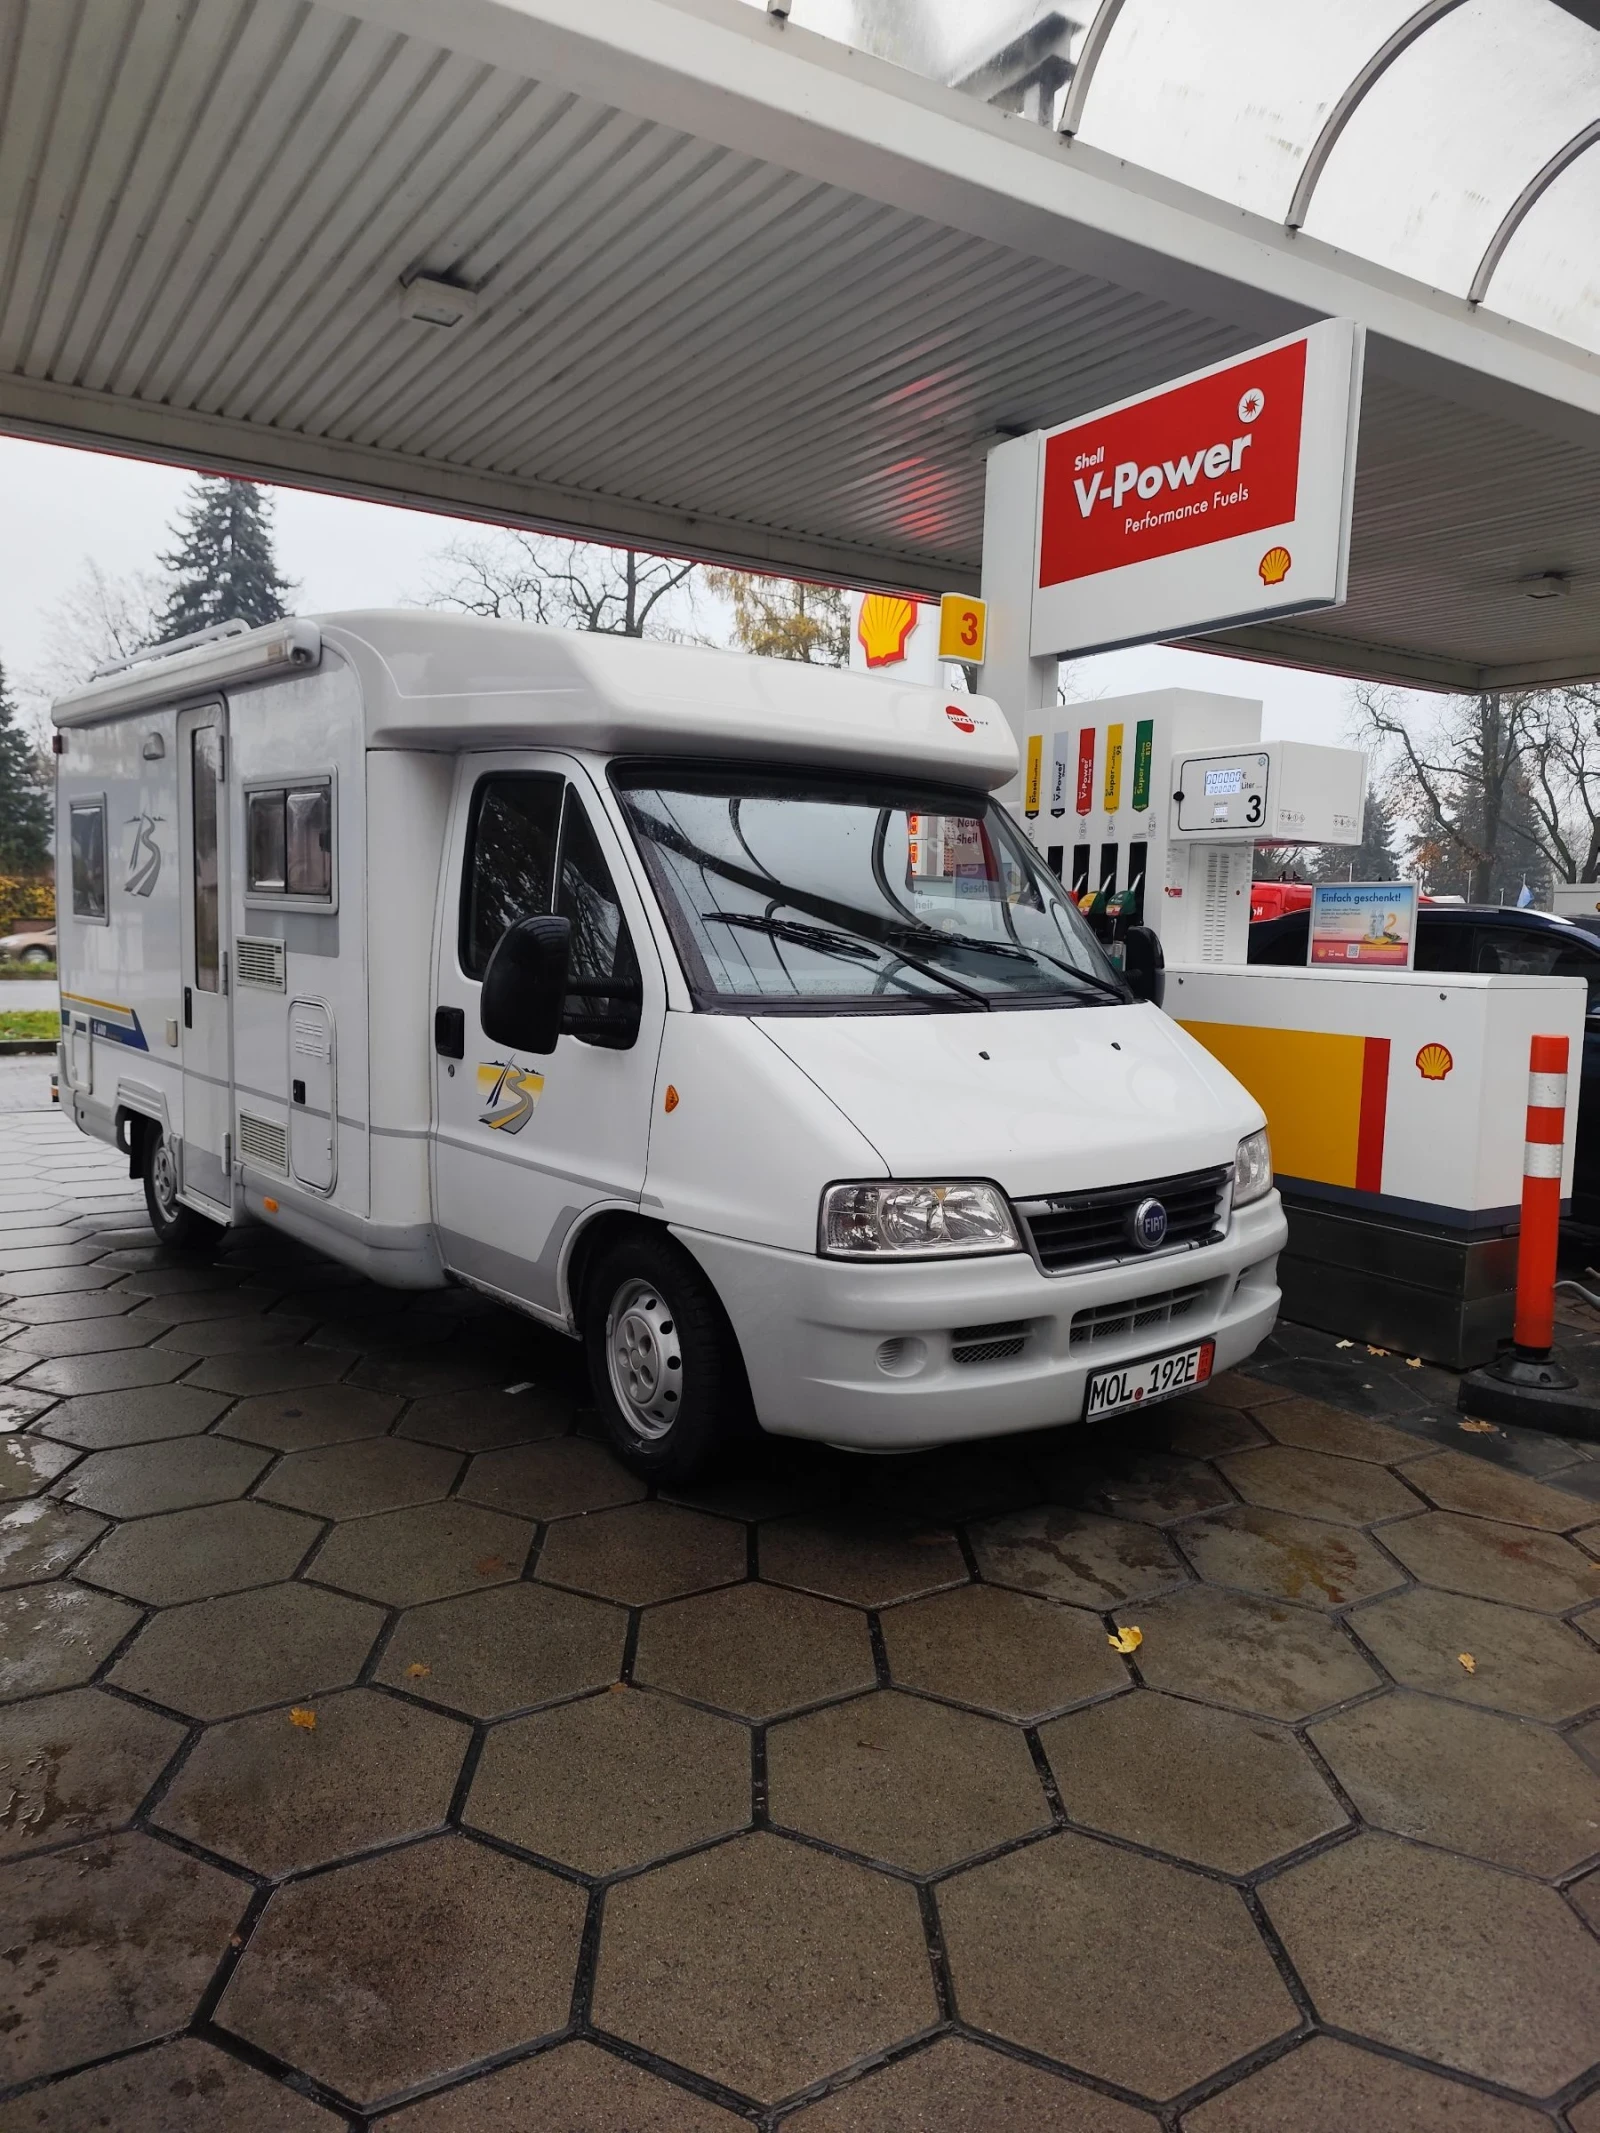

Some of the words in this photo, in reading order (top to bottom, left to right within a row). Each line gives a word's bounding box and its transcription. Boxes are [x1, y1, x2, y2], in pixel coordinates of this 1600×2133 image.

[1074, 446, 1105, 472] Shell
[1073, 433, 1253, 519] V-Power
[1125, 501, 1209, 535] Performance
[1213, 483, 1250, 509] Fuels
[961, 612, 978, 646] 3
[1116, 745, 1122, 756] 95
[1108, 769, 1116, 796] Super
[1137, 768, 1145, 794] Super
[1241, 781, 1256, 790] Liter
[1246, 795, 1262, 823] 3
[957, 833, 978, 845] Shell
[1321, 892, 1352, 903] Einfach
[1354, 892, 1401, 905] geschenkt!
[1144, 1215, 1164, 1233] FIAT
[1090, 1372, 1133, 1411] MOL
[1147, 1351, 1198, 1394] 192E
